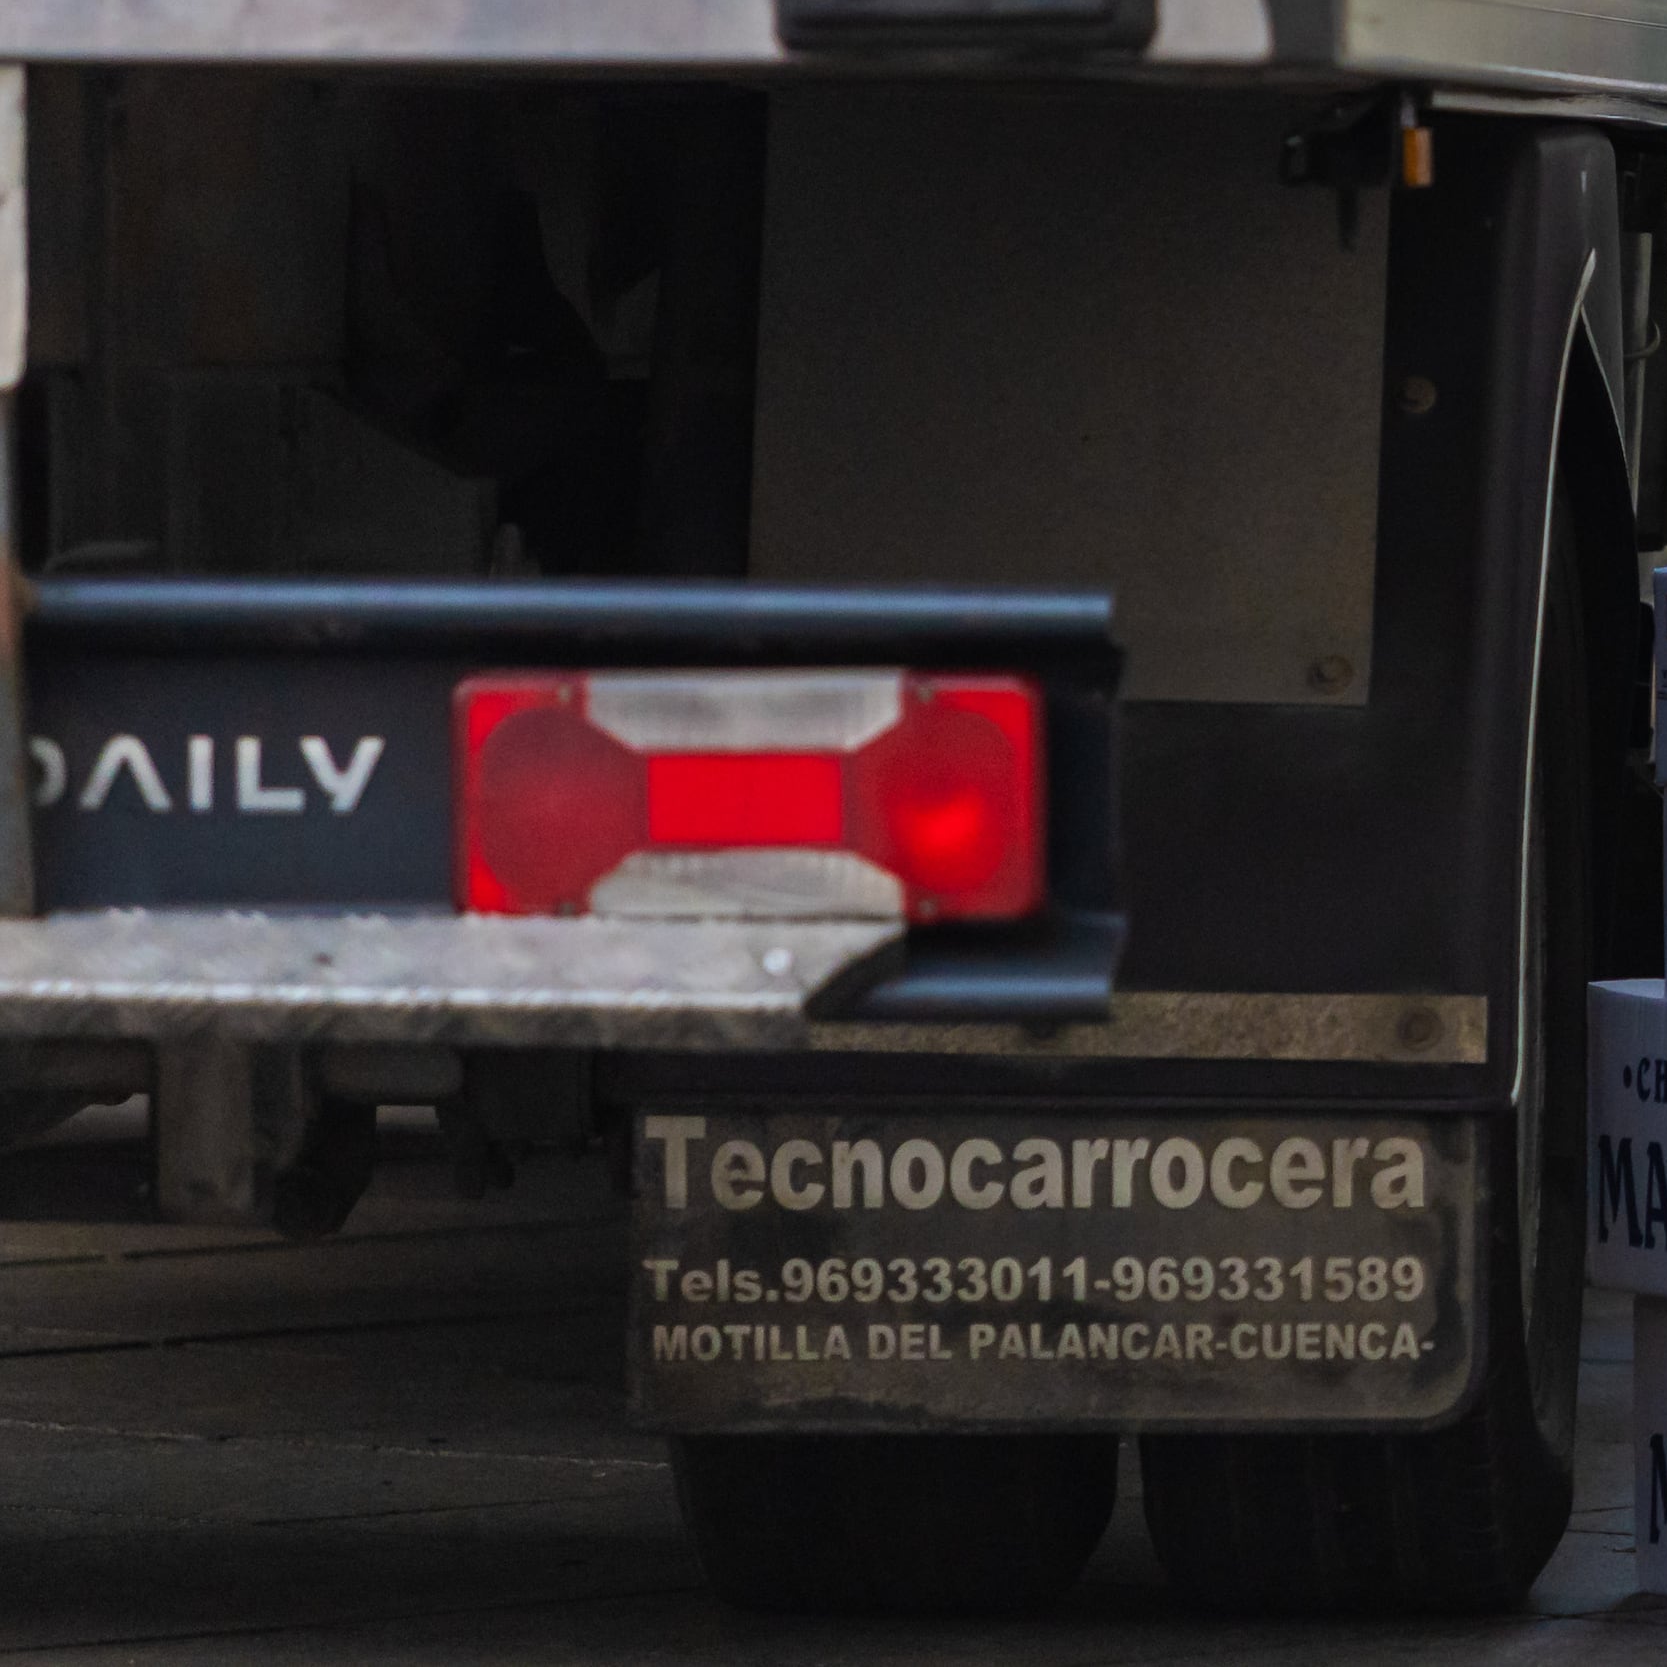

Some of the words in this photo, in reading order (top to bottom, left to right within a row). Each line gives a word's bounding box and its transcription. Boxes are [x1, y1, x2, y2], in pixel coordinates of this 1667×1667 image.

[644, 1115, 1425, 1210] Tecnocarrocera
[642, 1255, 1424, 1304] Tels.969333011-969331589
[652, 1322, 852, 1362] MOTILLA
[868, 1322, 952, 1362] DEL
